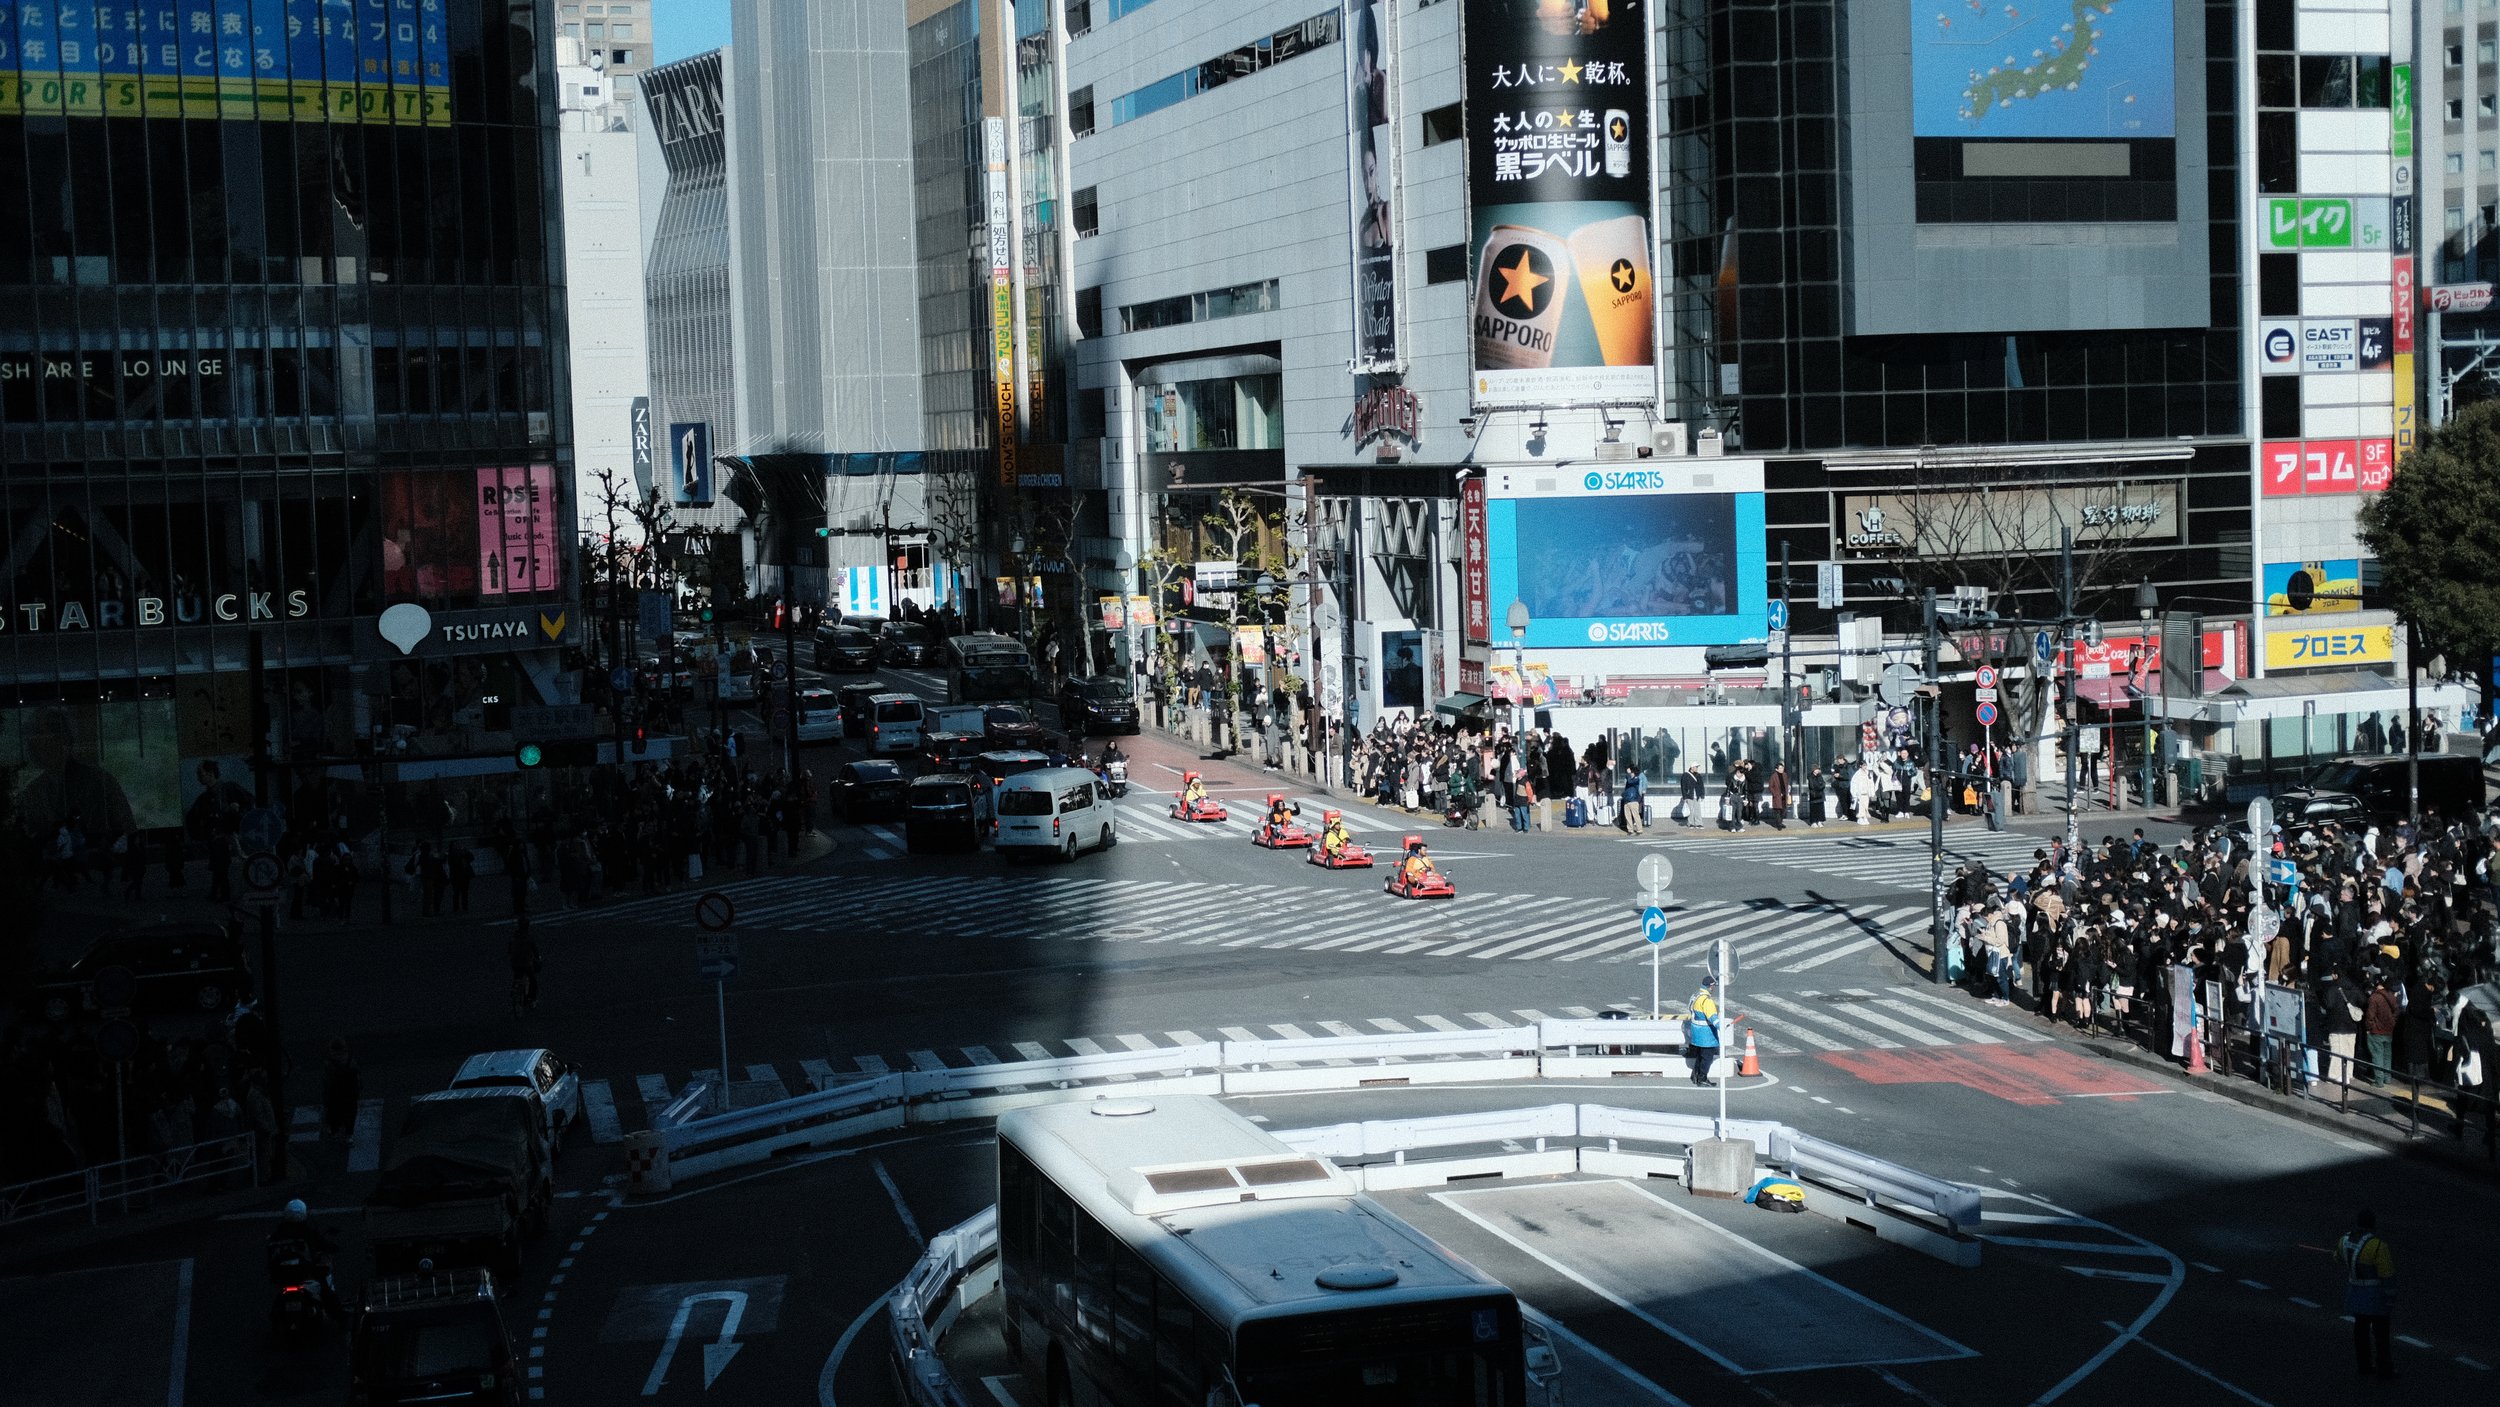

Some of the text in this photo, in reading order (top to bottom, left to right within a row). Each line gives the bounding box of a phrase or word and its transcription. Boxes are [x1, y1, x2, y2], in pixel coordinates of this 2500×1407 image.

[1491, 60, 1631, 89] 大人に 乾杯。
[2396, 73, 2408, 120] レイク
[651, 82, 724, 145] ZARA
[990, 121, 1004, 163] 皮ふ科
[1494, 133, 1601, 152] サッポロ生ビール
[1495, 150, 1601, 182] 黒ラベル
[992, 190, 1005, 220] 内科
[2275, 206, 2382, 245] レイク 5F
[992, 227, 1007, 266] 処方せん
[1612, 290, 1643, 309] SAPPORO
[2398, 290, 2410, 339] アコム
[1474, 314, 1552, 353] SAPPORO
[2305, 328, 2353, 341] EAST
[2361, 338, 2383, 359] 4F
[0, 358, 223, 379] SHARE LOUNGE
[635, 407, 650, 464] ZARA
[1001, 382, 1014, 484] MOM'S TOUCH
[2274, 444, 2387, 483] アコム 3F
[2362, 470, 2382, 485] 入口
[1605, 471, 1665, 490] STARTS
[515, 515, 541, 525] OPN
[1849, 533, 1900, 545] COFFEE
[1468, 508, 1484, 627] 天津甘栗
[0, 589, 309, 633] TARBUCKS
[442, 620, 529, 642] TSUTAYA
[1609, 622, 1669, 642] STARTS
[2291, 633, 2367, 659] プロミス
[1460, 667, 1484, 687] 天津甘栗
